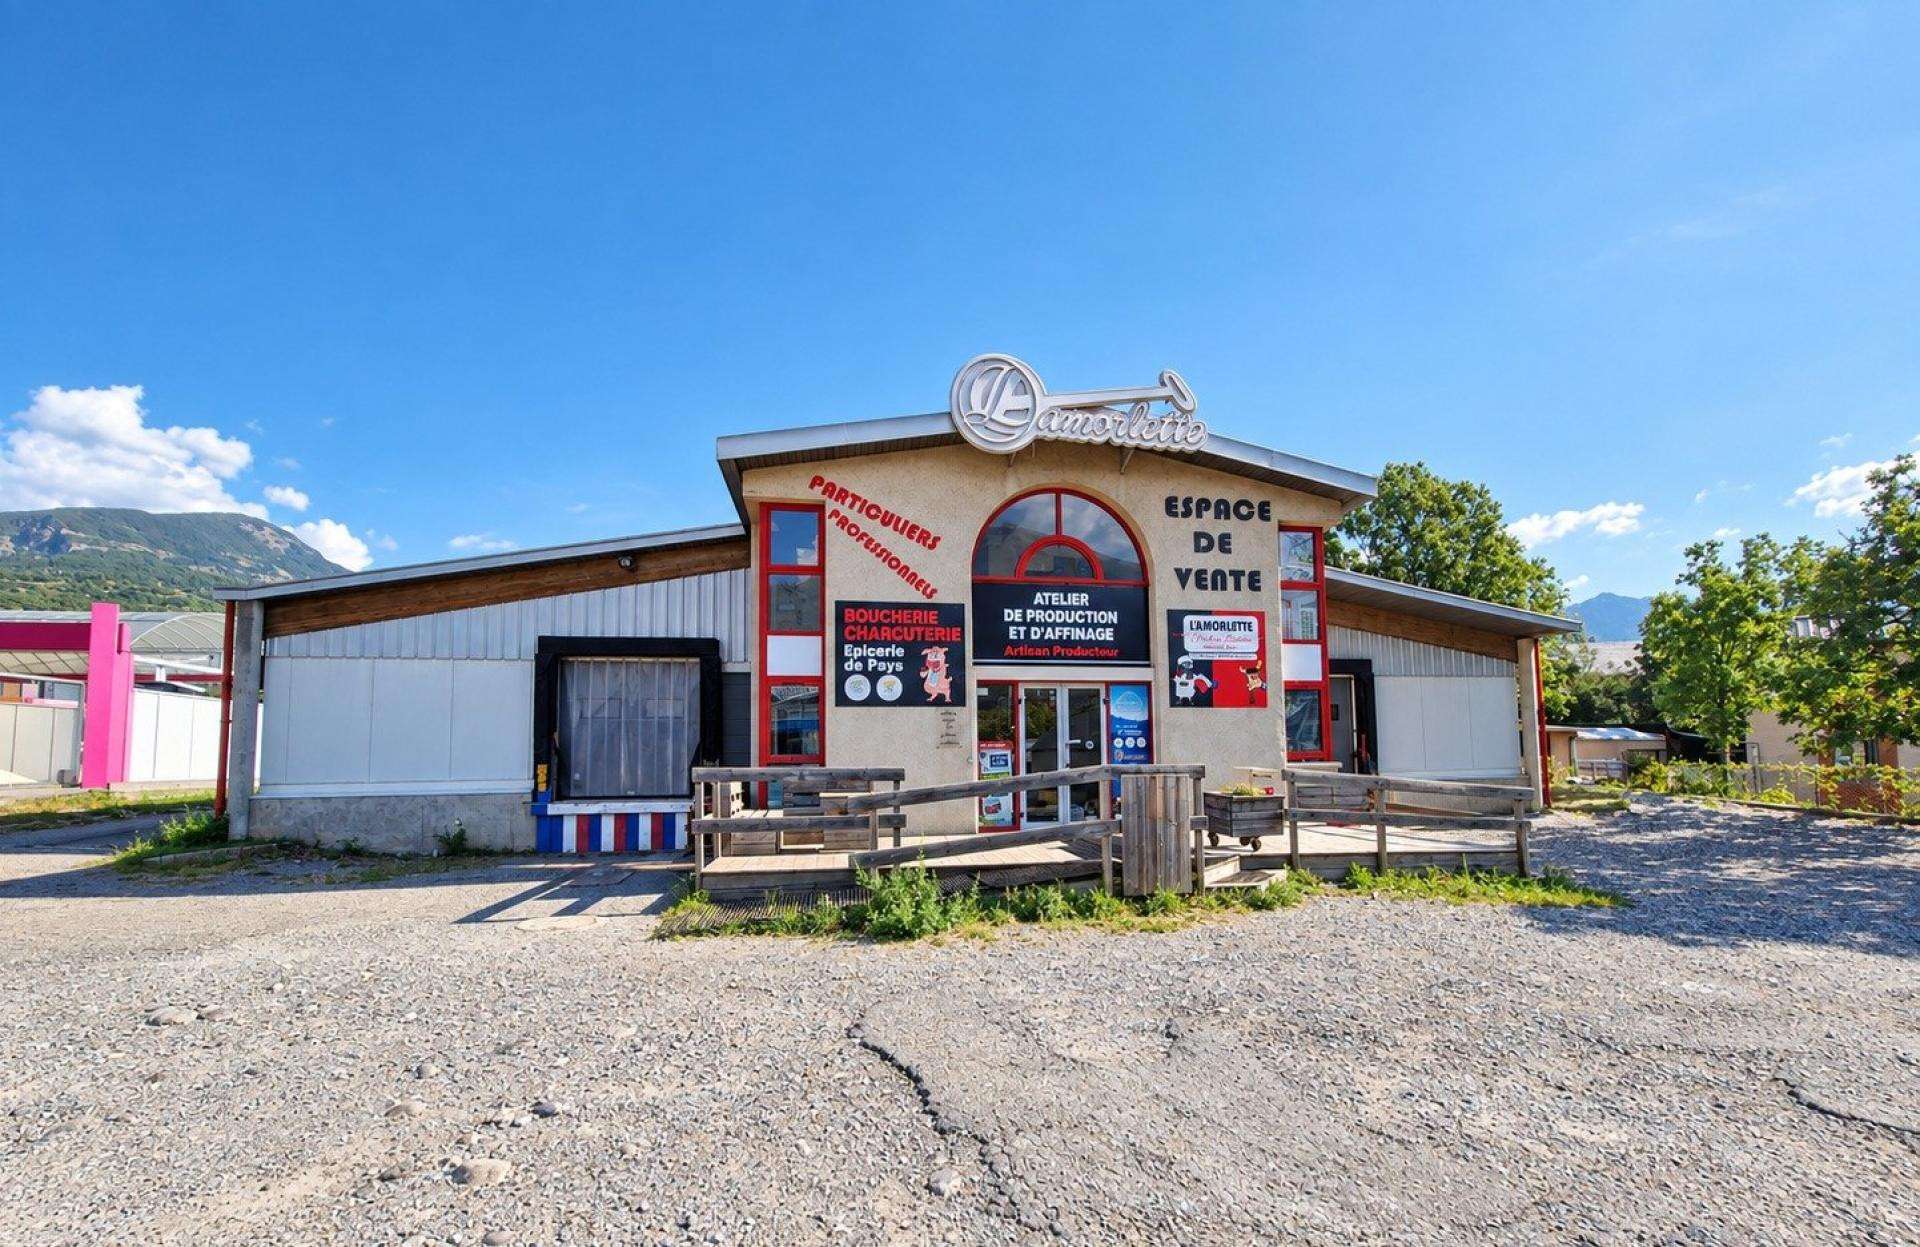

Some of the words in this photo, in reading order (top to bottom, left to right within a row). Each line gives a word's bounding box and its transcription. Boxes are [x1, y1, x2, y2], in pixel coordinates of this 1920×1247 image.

[808, 475, 942, 551] PARTICULIERS
[1164, 496, 1271, 522] ESPACE
[1193, 531, 1232, 554] DE
[827, 509, 938, 599] PROFESSIONNELS
[1173, 567, 1262, 592] VENTE
[1033, 591, 1090, 606] ATELIER
[844, 607, 939, 624] BOUCHERIE
[1003, 609, 1023, 622] DE
[1026, 610, 1118, 624] PRODUCTION
[843, 624, 962, 641] CHARCUTERIE
[1008, 626, 1026, 640] ET
[1030, 626, 1114, 641] D'AFFINAGE
[1189, 620, 1254, 632] L'AMORLETTE
[843, 643, 905, 660] Epicerie
[1003, 645, 1050, 657] Artisan
[1053, 645, 1119, 657] Producteur
[843, 658, 864, 672] de
[867, 659, 904, 674] Pays
